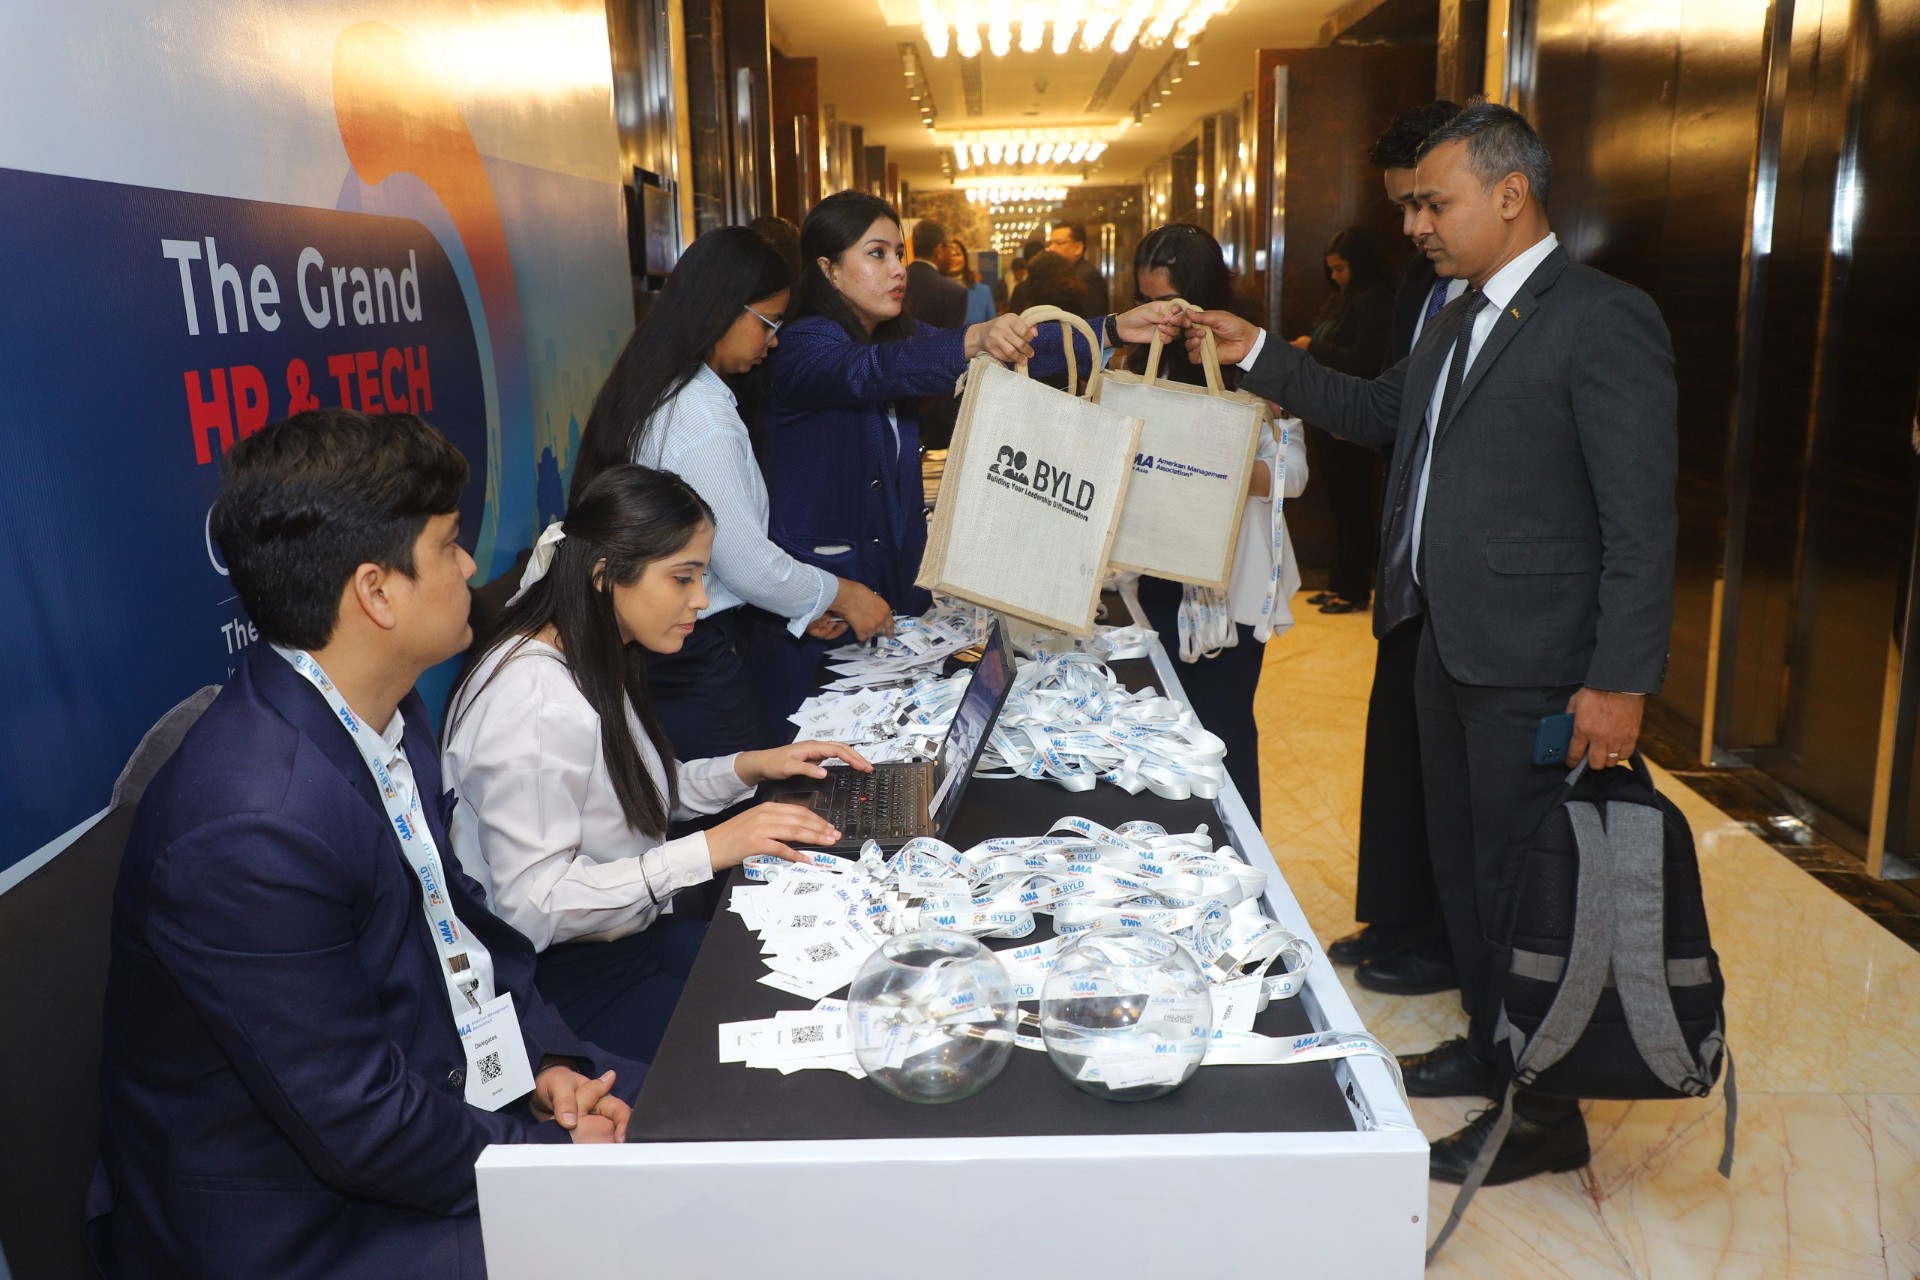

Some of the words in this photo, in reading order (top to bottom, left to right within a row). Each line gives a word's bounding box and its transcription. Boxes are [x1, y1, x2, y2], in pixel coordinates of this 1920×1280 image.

[161, 236, 281, 336] The
[297, 246, 422, 329] Grand
[286, 358, 320, 420] &
[327, 345, 433, 415] TECH
[1133, 453, 1154, 468] MA
[1157, 458, 1186, 470] American
[1187, 465, 1228, 480] Management
[1032, 459, 1095, 511] BYLD
[986, 473, 1010, 489] Building
[1011, 482, 1024, 493] Your
[1024, 488, 1052, 506] Leadership
[1053, 499, 1089, 522] Differentiators
[221, 618, 258, 654] The
[295, 654, 320, 678] BYLD
[340, 706, 359, 733] AMA
[1046, 748, 1060, 766] AMA
[373, 758, 390, 786] BYLD
[394, 814, 412, 841] AMA
[1069, 819, 1090, 832] AMA
[916, 842, 940, 852] BYLD
[814, 854, 838, 865] AMA
[1138, 852, 1154, 860] MA
[1068, 864, 1092, 874] AMA
[1139, 864, 1164, 875] AMA
[420, 866, 436, 892] BYLD
[1114, 878, 1139, 888] AMA
[1062, 880, 1084, 893] BYLD
[1020, 892, 1039, 904] AMA
[1168, 898, 1195, 906] BYLD
[866, 904, 888, 917] AMA
[923, 900, 950, 912] BYLD
[938, 916, 956, 926] MA
[990, 914, 1016, 922] BYLD
[1120, 918, 1142, 928] AMA
[438, 920, 456, 945] AMA
[1012, 920, 1032, 936] BYLD
[1014, 946, 1042, 960] AMA
[1015, 986, 1034, 995] YLD
[1072, 982, 1098, 992] AMA
[1270, 982, 1291, 992] YLD
[950, 992, 975, 1006] AMA
[458, 1024, 472, 1037] MA
[474, 1034, 498, 1050] Delegates
[1294, 1036, 1320, 1050] AMA
[1336, 1042, 1368, 1051] AMA
[1155, 1044, 1177, 1054] MA
